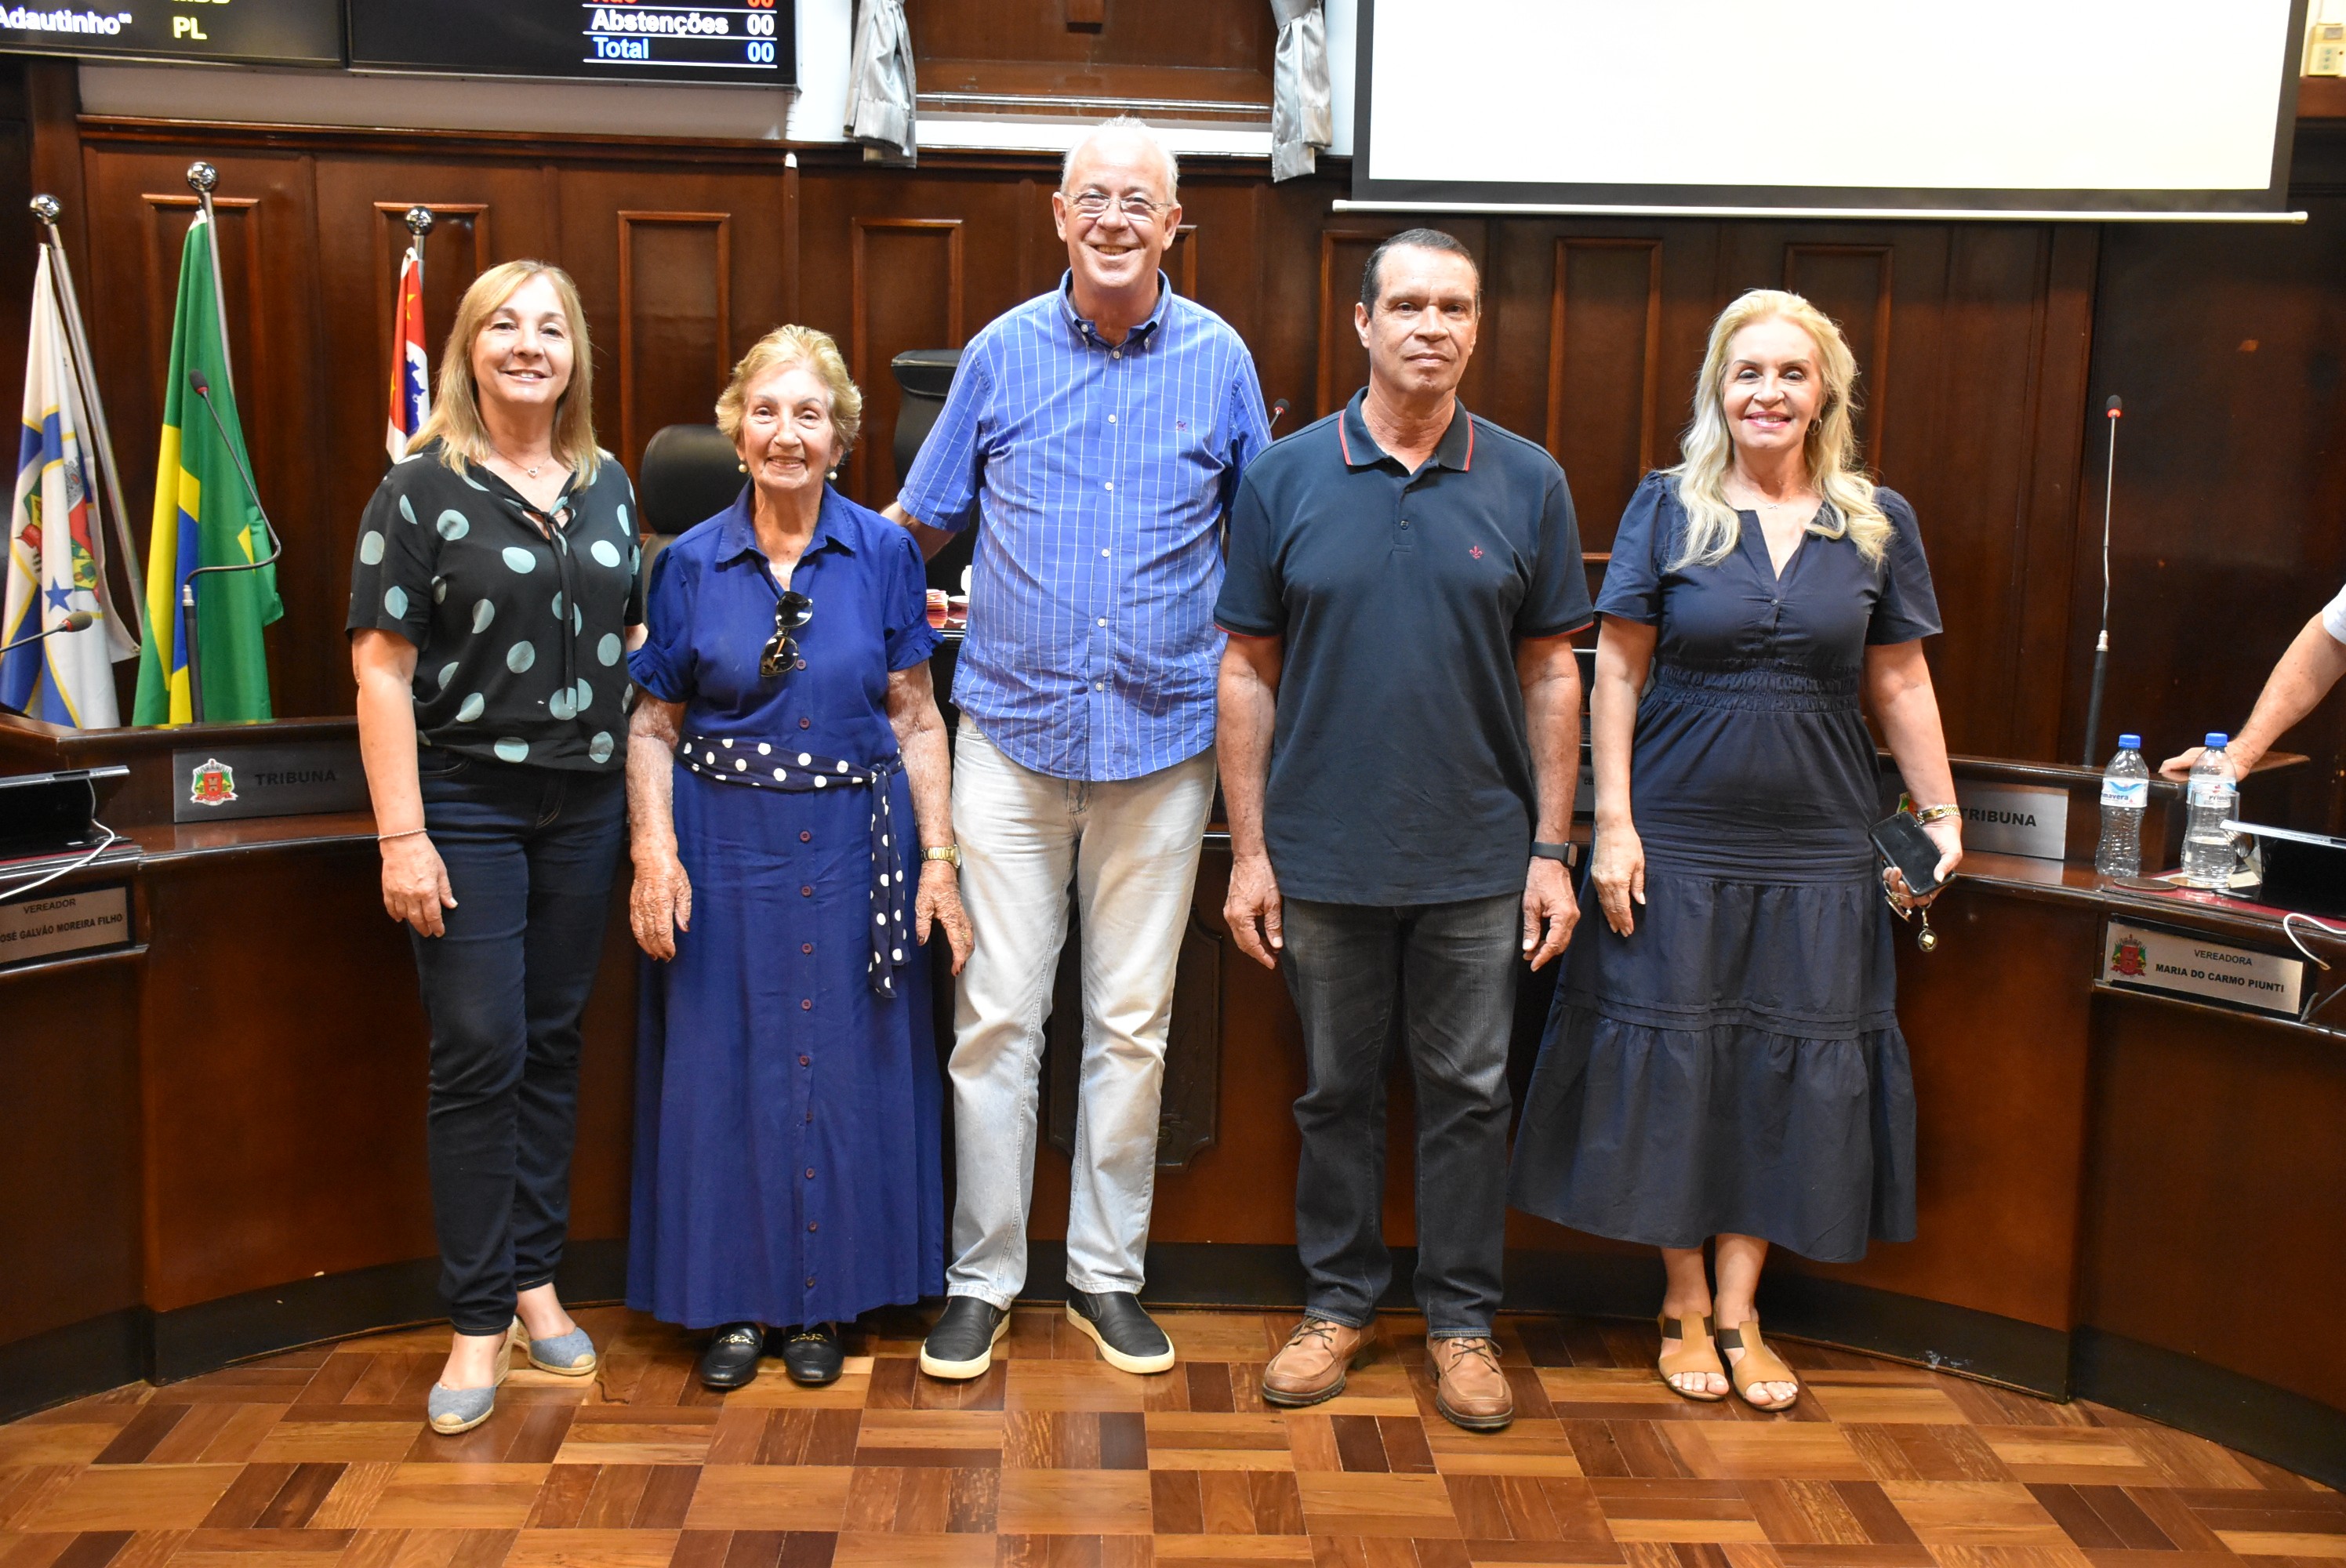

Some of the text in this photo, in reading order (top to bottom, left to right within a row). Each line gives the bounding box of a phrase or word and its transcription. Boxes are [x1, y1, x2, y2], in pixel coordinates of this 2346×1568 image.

[173, 16, 207, 39] PL
[591, 9, 774, 38] Abstenções 00
[593, 37, 775, 62] Total 00
[255, 769, 337, 786] TRIBUNA
[24, 898, 76, 914] VEREADOR
[0, 930, 17, 943] OSÉ
[56, 918, 96, 933] MOREIRA
[98, 913, 123, 926] FILHO
[2194, 949, 2253, 966] VEREADORA
[2155, 964, 2285, 993] MARIA DO CARMO PIUNTI
